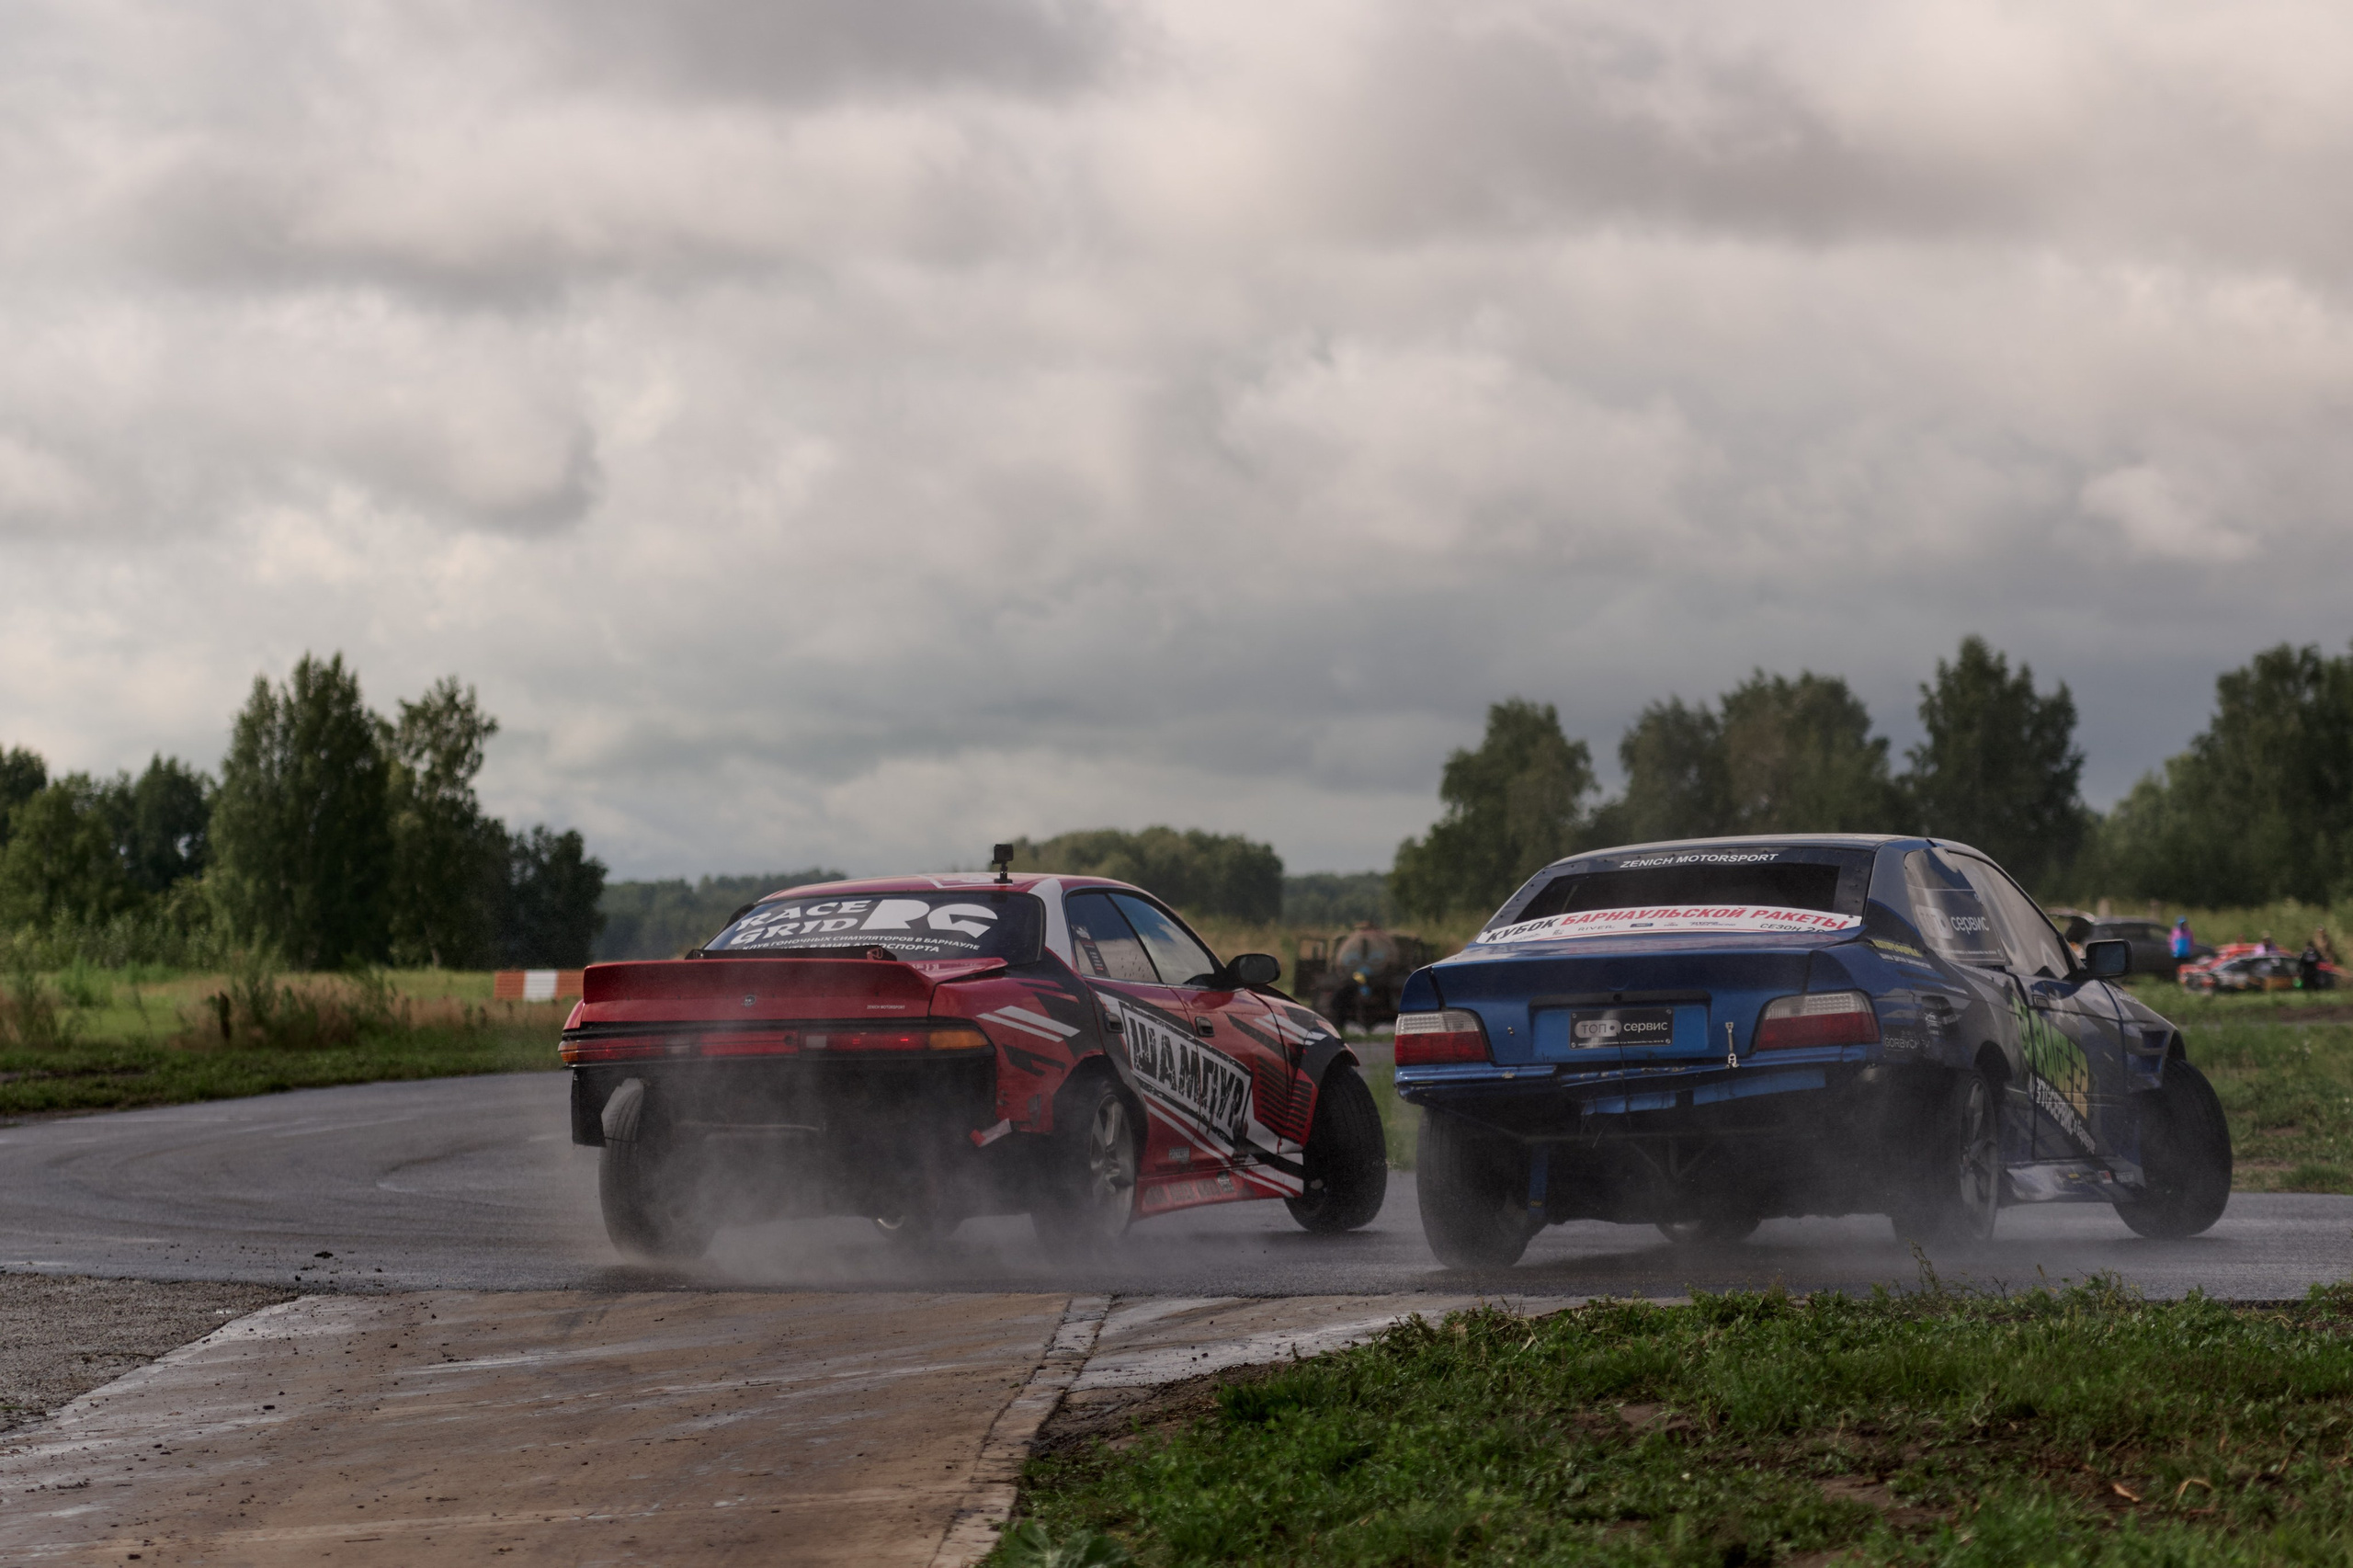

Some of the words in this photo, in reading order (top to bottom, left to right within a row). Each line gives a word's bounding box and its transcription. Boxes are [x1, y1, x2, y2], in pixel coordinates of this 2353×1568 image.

[1620, 857, 1674, 869] ZENICH
[1676, 853, 1779, 864] MOTORSPORT
[735, 900, 872, 932] RACE
[1484, 917, 1560, 943] КУБОК
[1560, 907, 1746, 926] БАРНАУЛЬСКОЙ
[1750, 909, 1849, 929] РАКЕТЫ
[1950, 916, 1990, 935] сервис
[730, 917, 858, 945] GRID
[1760, 923, 1802, 931] СЕЗОН
[742, 942, 769, 950] КЛУБ
[770, 937, 832, 947] ГОНОЧНЫХ
[833, 935, 914, 943] СИМУЛЯТОРОВ
[924, 937, 981, 950] БАРНАУЛЕ
[1581, 1024, 1607, 1034] ТОП
[1623, 1022, 1668, 1033] сервис
[1128, 1017, 1245, 1128] ШАМПУР
